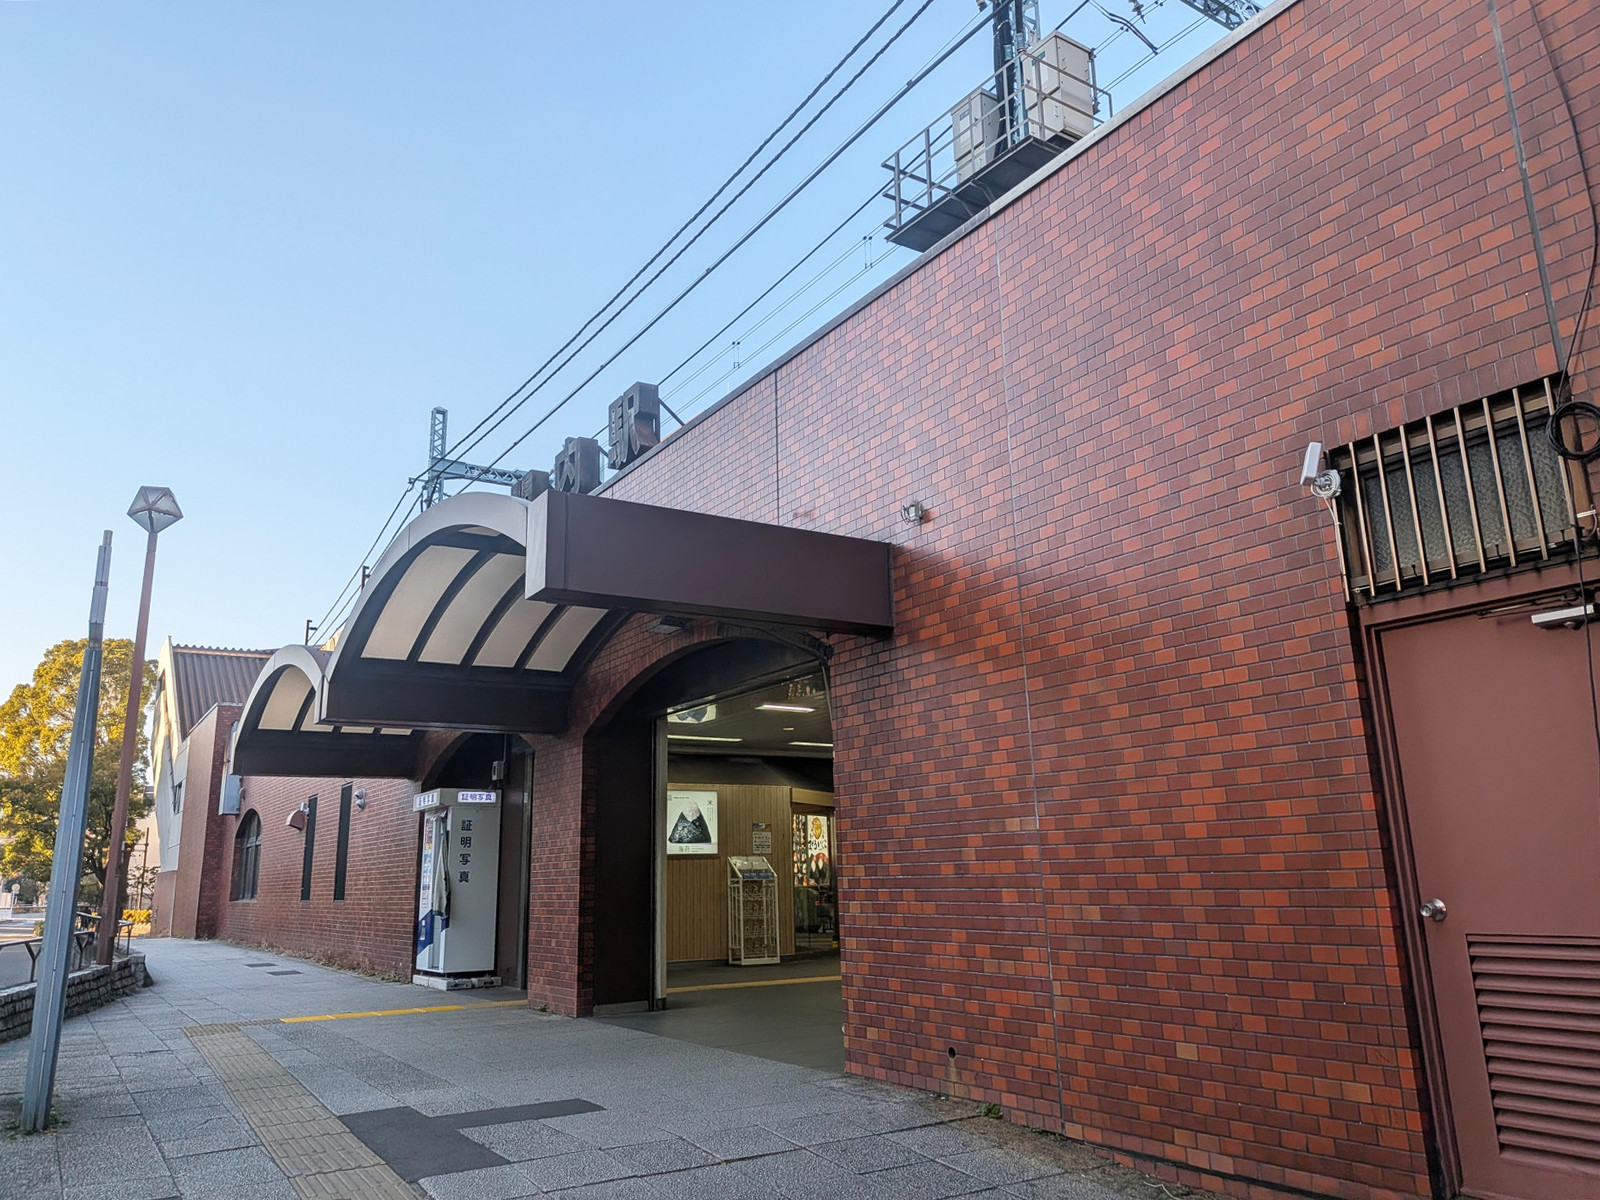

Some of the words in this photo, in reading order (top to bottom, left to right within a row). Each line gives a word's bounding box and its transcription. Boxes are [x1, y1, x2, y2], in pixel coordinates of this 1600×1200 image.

[461, 793, 492, 801] 証明写真
[459, 819, 472, 883] 証明写真
